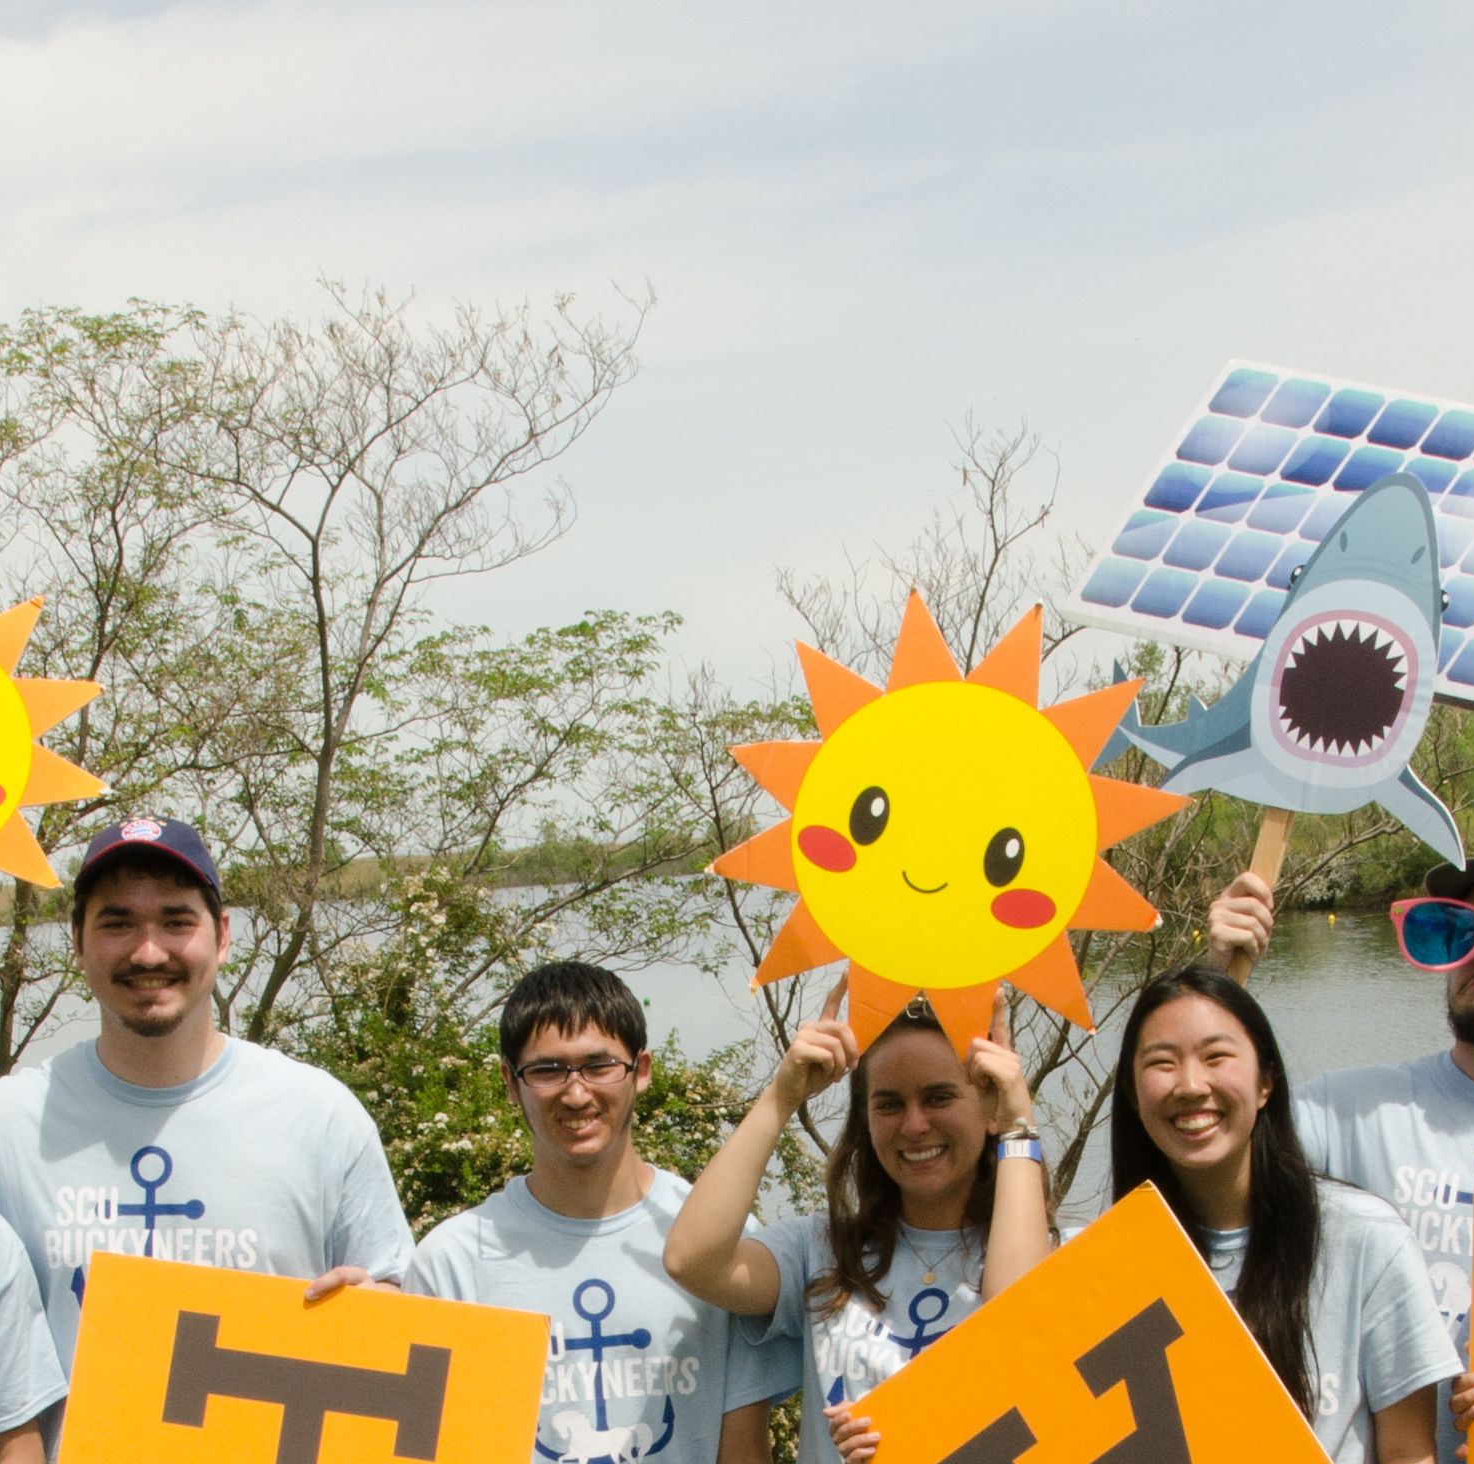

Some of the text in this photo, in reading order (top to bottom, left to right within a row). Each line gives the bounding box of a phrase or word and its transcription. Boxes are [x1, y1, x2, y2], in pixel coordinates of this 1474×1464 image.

[55, 1185, 119, 1227] SCU
[1392, 1164, 1461, 1211] SCU
[44, 1227, 258, 1270] BUCKYNEERS
[540, 1356, 700, 1406] CKYNEERS
